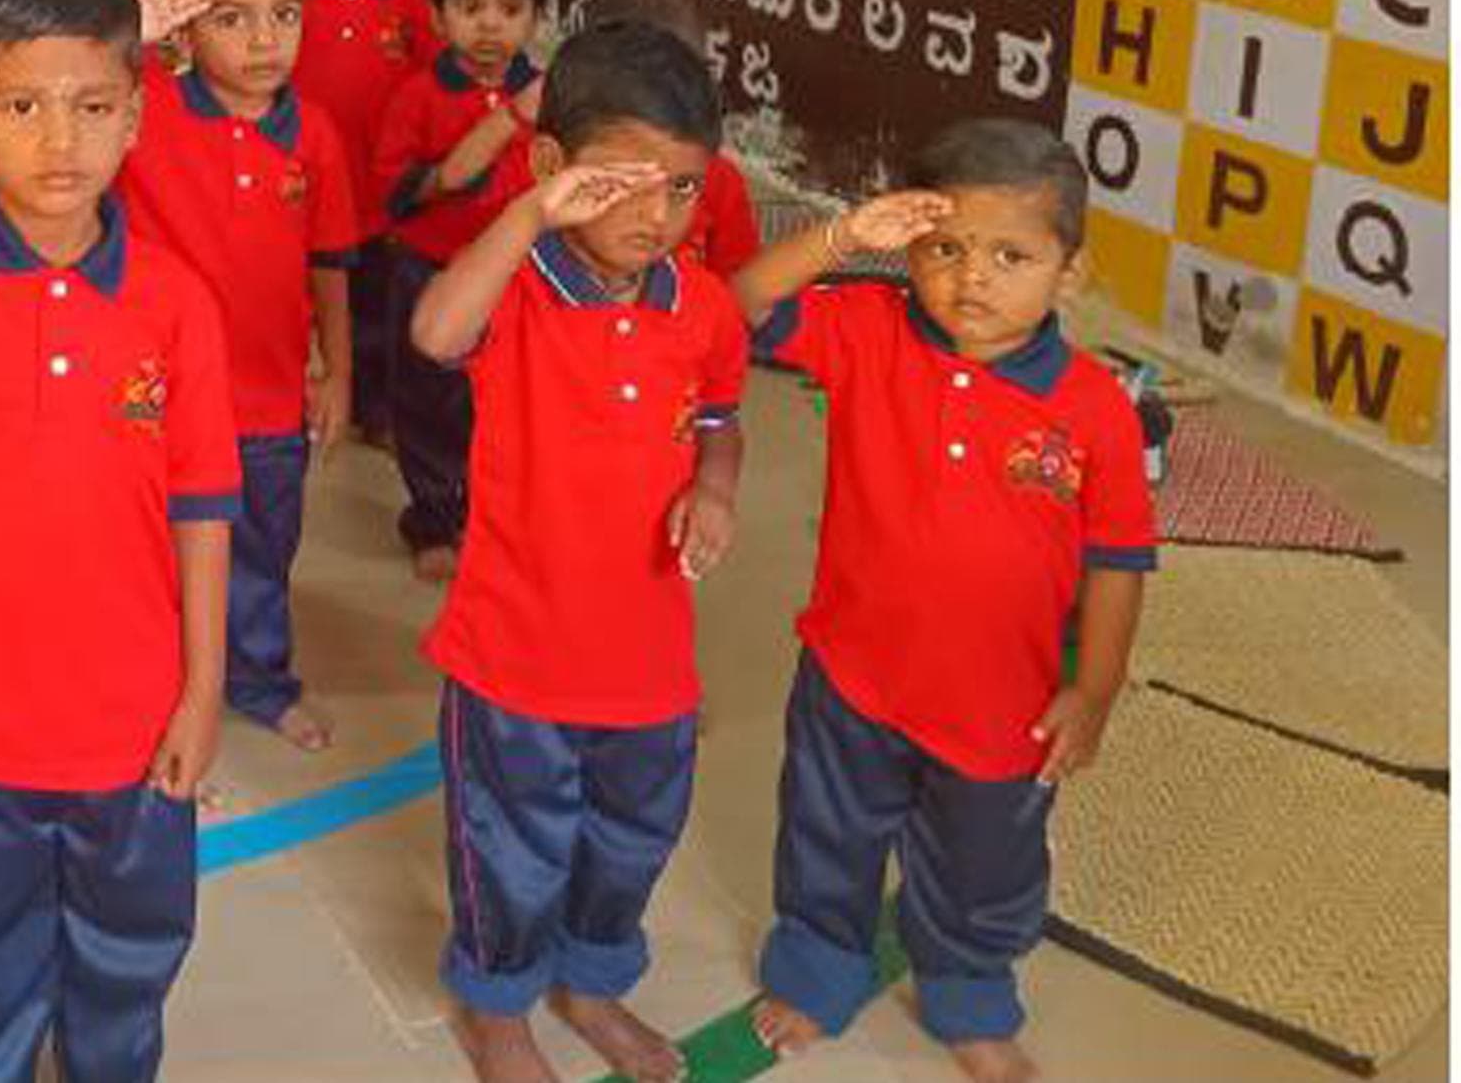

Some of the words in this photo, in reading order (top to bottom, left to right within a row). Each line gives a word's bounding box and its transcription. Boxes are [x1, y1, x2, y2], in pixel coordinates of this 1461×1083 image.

[926, 2, 976, 76] ವ
[997, 21, 1053, 100] ಶ
[1238, 35, 1262, 119] I
[1361, 81, 1431, 167] J
[1086, 113, 1140, 192] O
[1206, 148, 1270, 229] P
[1336, 199, 1413, 297] Q
[1310, 313, 1402, 423] W
